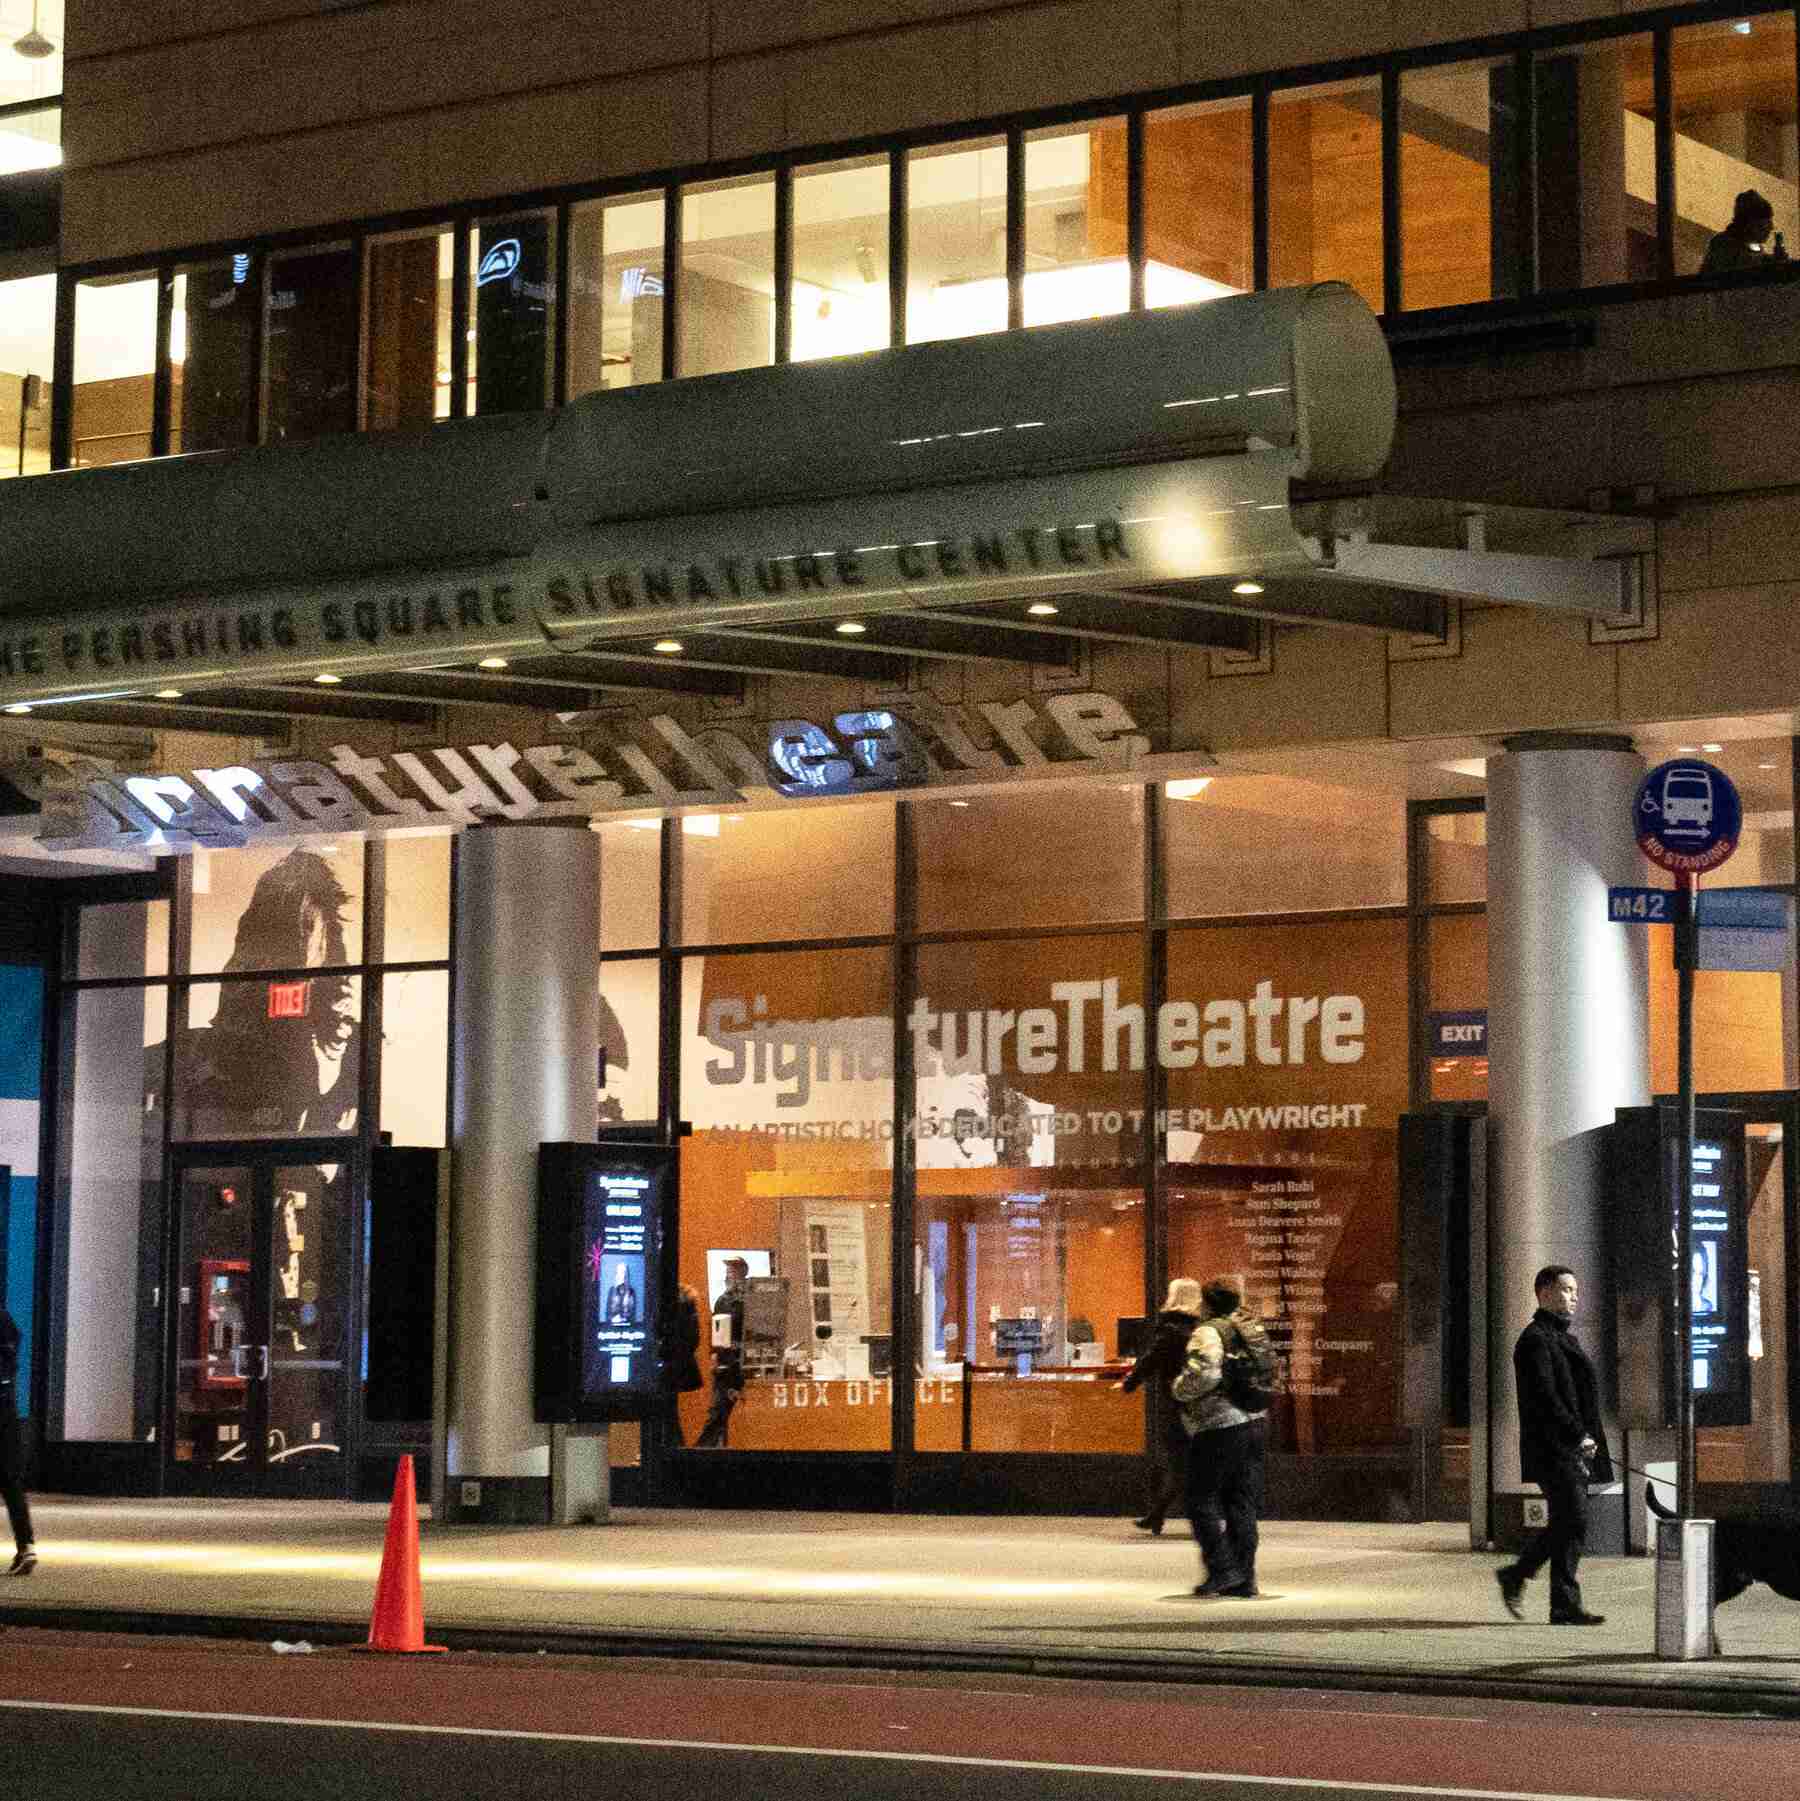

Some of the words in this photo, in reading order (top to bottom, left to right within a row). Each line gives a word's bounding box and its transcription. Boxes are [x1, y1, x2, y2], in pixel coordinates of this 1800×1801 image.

[62, 606, 298, 669] PERSHING
[321, 582, 517, 646] SQUARE
[548, 545, 867, 614] SIGNATURE
[897, 519, 1131, 579] CENTER
[1646, 837, 1665, 857] NO
[1664, 840, 1731, 869] STANDING
[1612, 894, 1665, 918] M42
[1440, 1025, 1485, 1042] EXIT
[749, 1119, 852, 1144] ARTISTIC
[1087, 1109, 1123, 1135] TO
[1189, 1103, 1367, 1132] PLAYWRIGHT
[773, 1382, 829, 1408] BOX
[847, 1377, 956, 1408] OFCE
